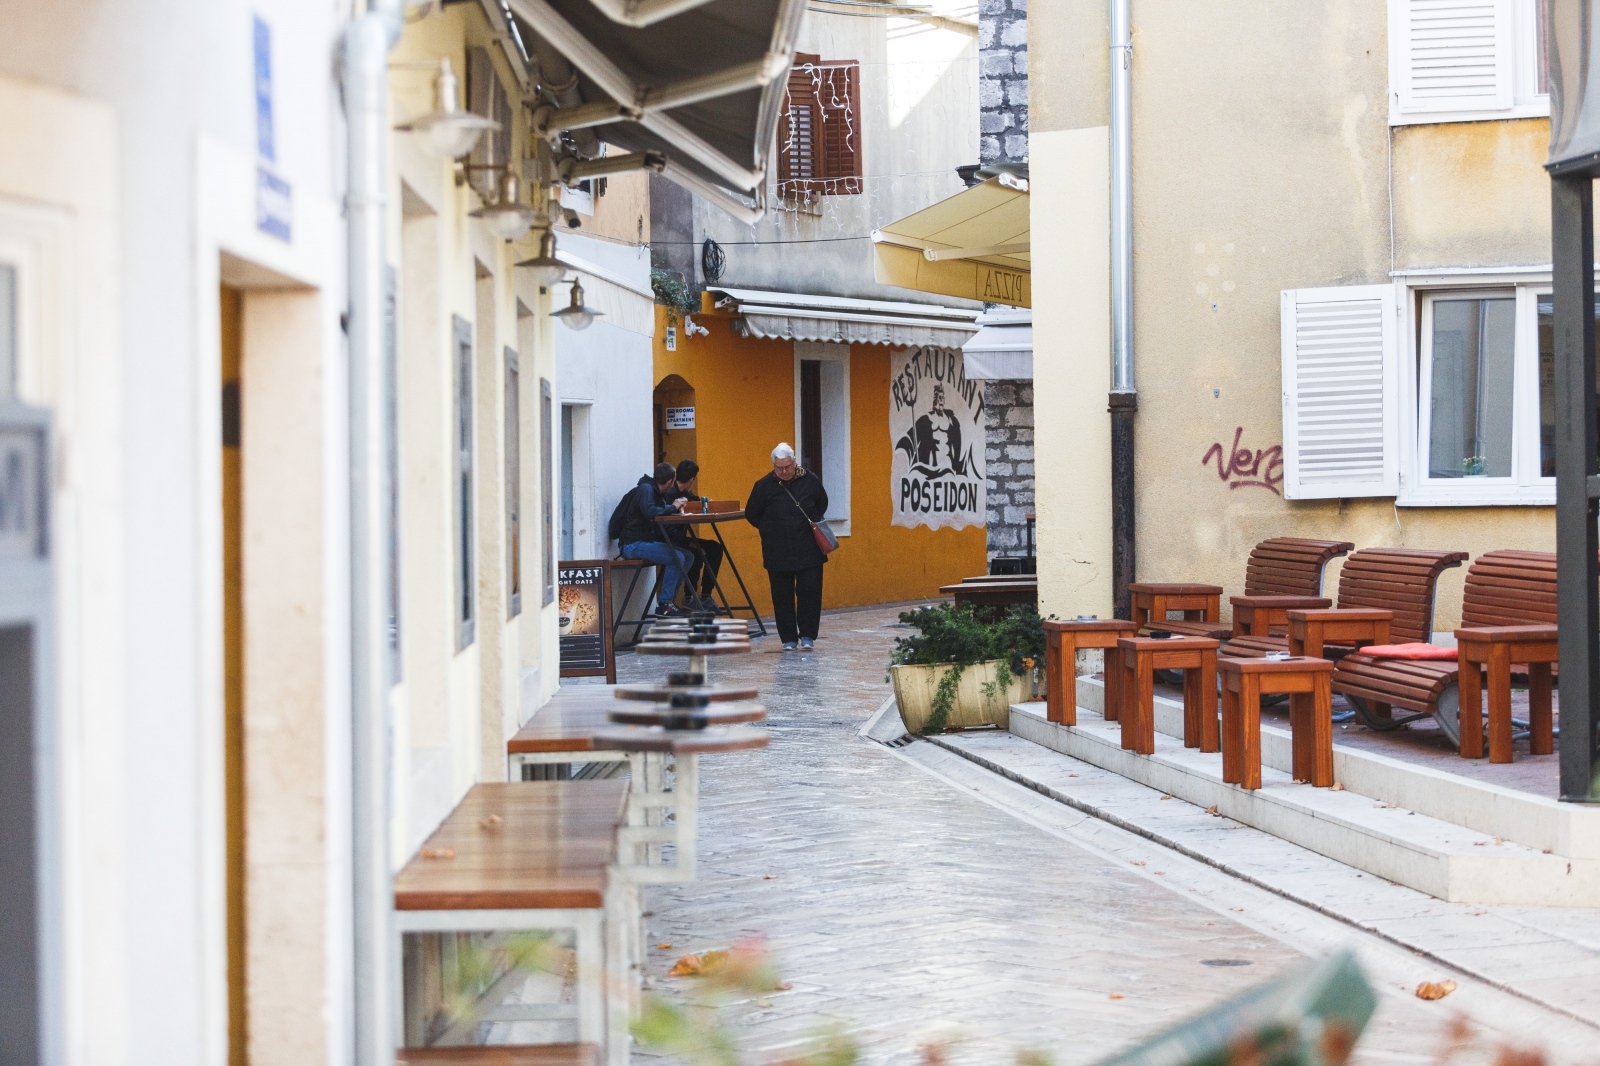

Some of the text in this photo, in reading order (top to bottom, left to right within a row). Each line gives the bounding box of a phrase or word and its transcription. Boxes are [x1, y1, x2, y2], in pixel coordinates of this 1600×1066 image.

[891, 348, 984, 425] RESTAURANT
[900, 477, 977, 513] POSEIDON
[559, 569, 600, 579] KFAST
